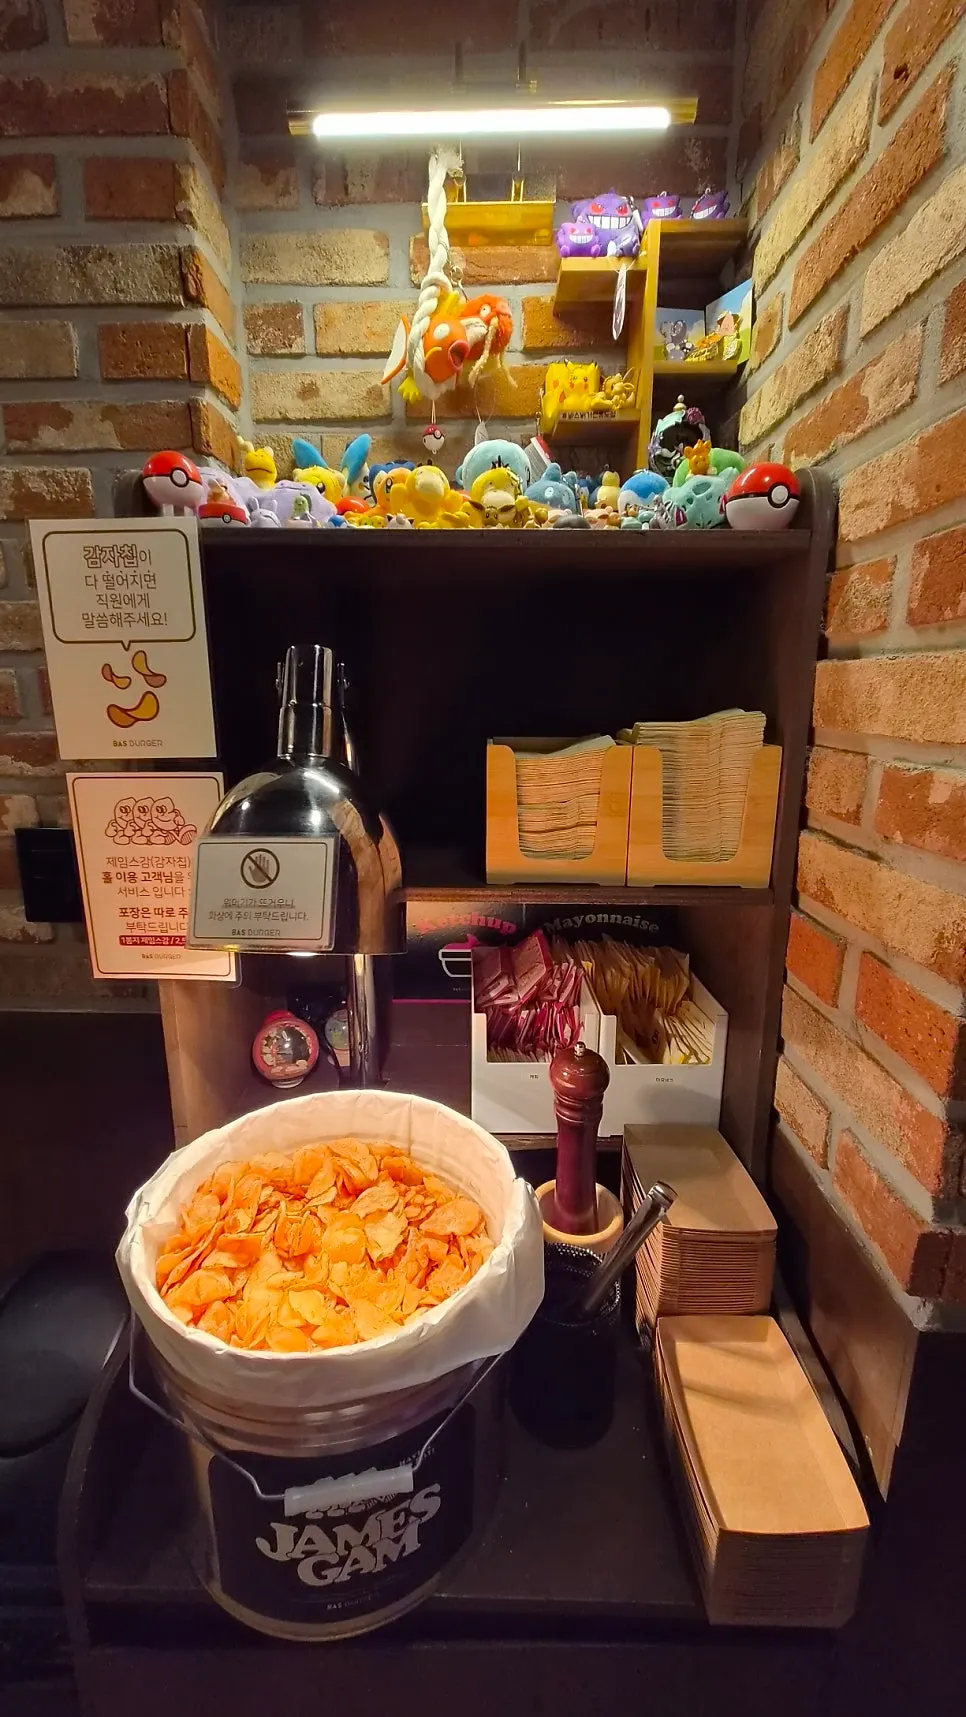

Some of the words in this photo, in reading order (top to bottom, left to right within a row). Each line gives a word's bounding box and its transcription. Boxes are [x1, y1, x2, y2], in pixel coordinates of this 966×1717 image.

[82, 543, 152, 569] 감자칩이
[84, 573, 98, 590] 다
[102, 571, 157, 591] 떨어지면
[95, 592, 151, 610] 직원에게
[81, 611, 168, 629] 말씀해주세요!
[112, 740, 128, 748] BAS
[105, 856, 191, 869] 제임스감(감자칩)
[101, 871, 113, 884] 홀
[115, 871, 138, 884] 이용
[140, 871, 185, 884] 고객님을
[117, 886, 151, 898] 서비스
[152, 886, 185, 899] 입니다
[118, 907, 152, 919] 포장은
[153, 907, 176, 919] 따로
[177, 907, 189, 919] 주
[235, 910, 252, 922] 주의
[253, 910, 309, 922] 부탁드립니다.
[231, 928, 246, 937] BAS
[416, 912, 517, 936] Ketchup
[543, 913, 660, 934] Mayonnaise
[255, 1483, 441, 1562] JAMES
[297, 1517, 422, 1587] GAM
